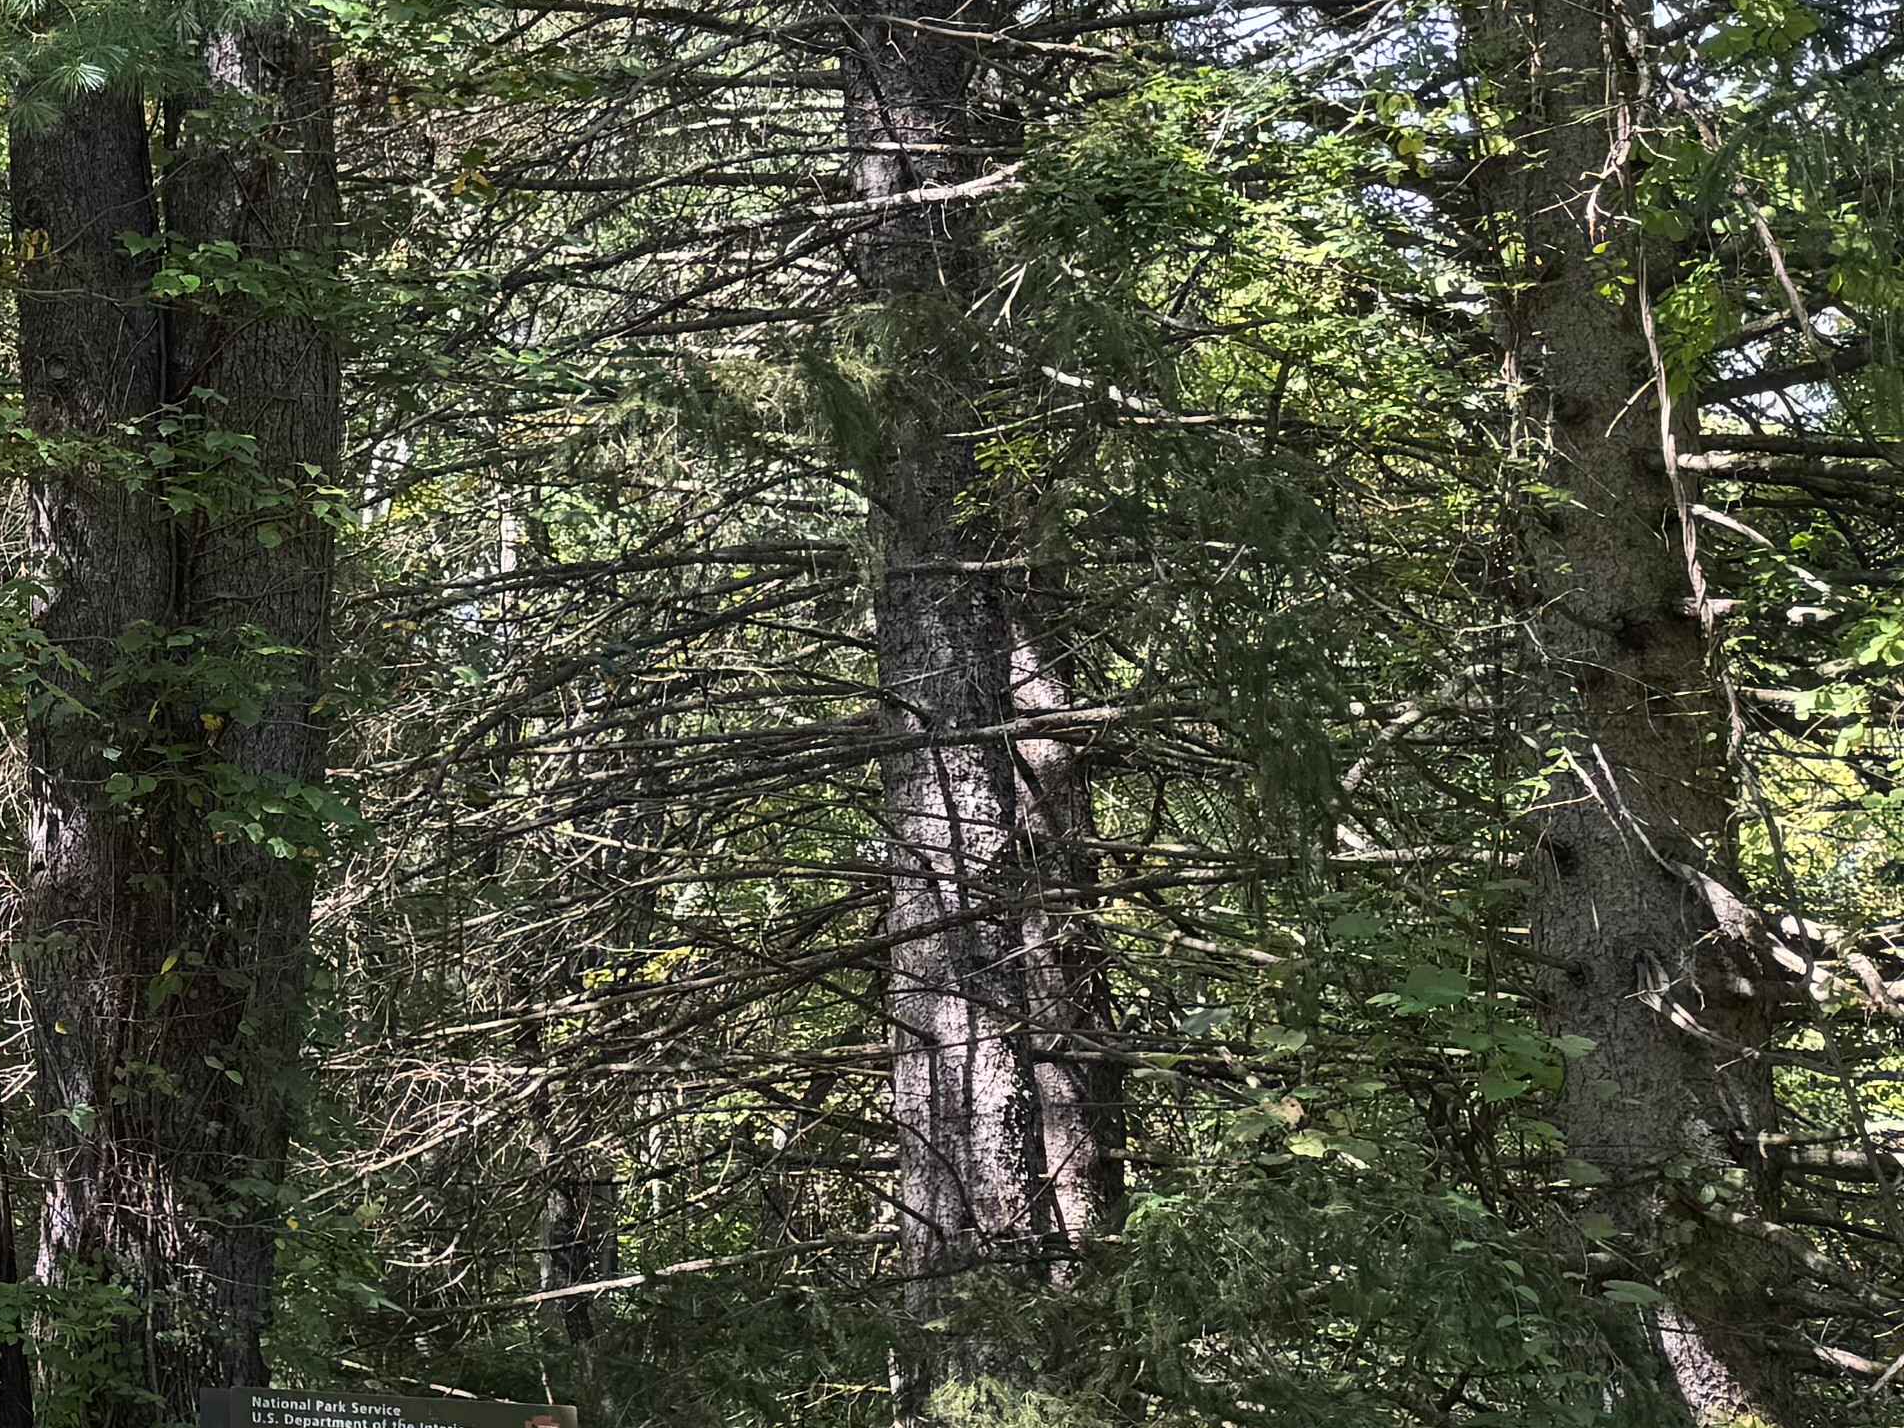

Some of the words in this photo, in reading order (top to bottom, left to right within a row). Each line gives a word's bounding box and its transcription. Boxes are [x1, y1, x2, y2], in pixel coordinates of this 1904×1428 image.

[252, 1395, 311, 1411] National
[316, 1400, 346, 1413] Park
[351, 1402, 401, 1416] Service
[252, 1411, 279, 1424] U.S.
